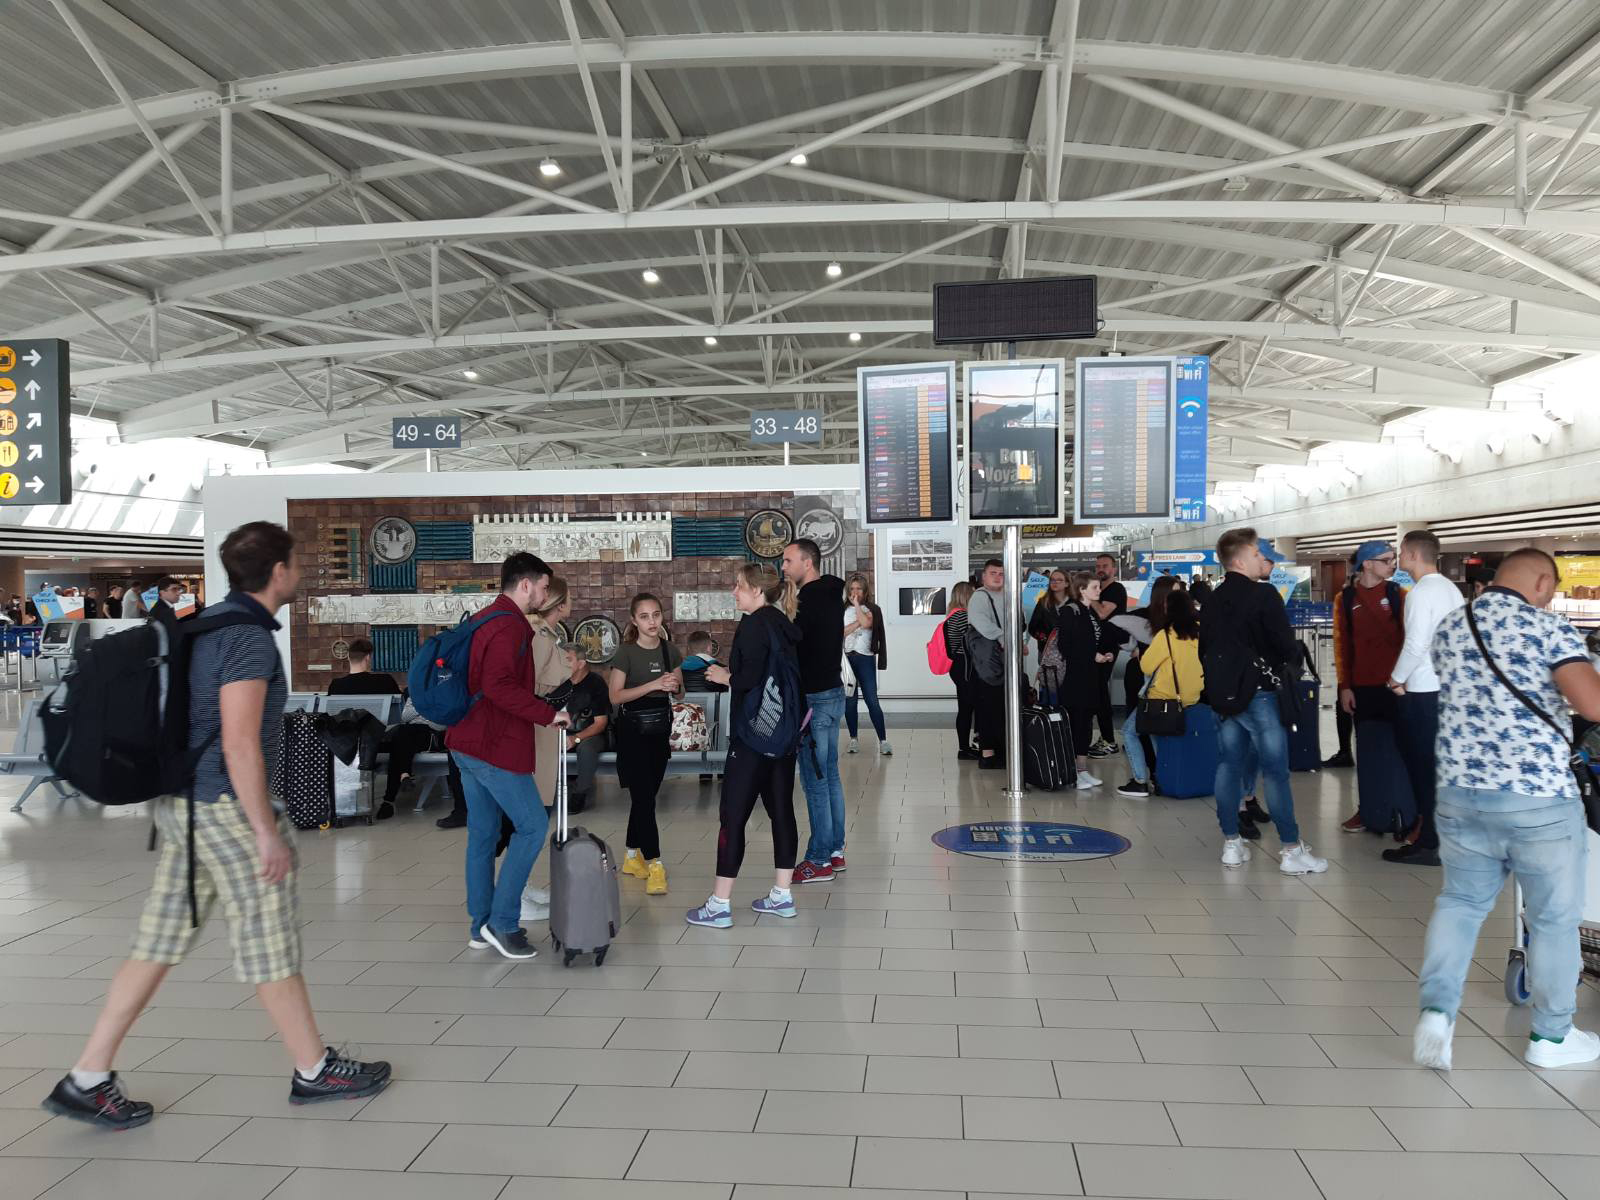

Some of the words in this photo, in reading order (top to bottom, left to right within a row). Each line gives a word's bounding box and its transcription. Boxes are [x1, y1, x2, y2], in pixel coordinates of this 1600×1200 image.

[396, 424, 418, 441] 49
[435, 423, 457, 441] 64
[754, 418, 777, 435] 33
[794, 416, 817, 434] 48
[749, 676, 784, 741] NIKE
